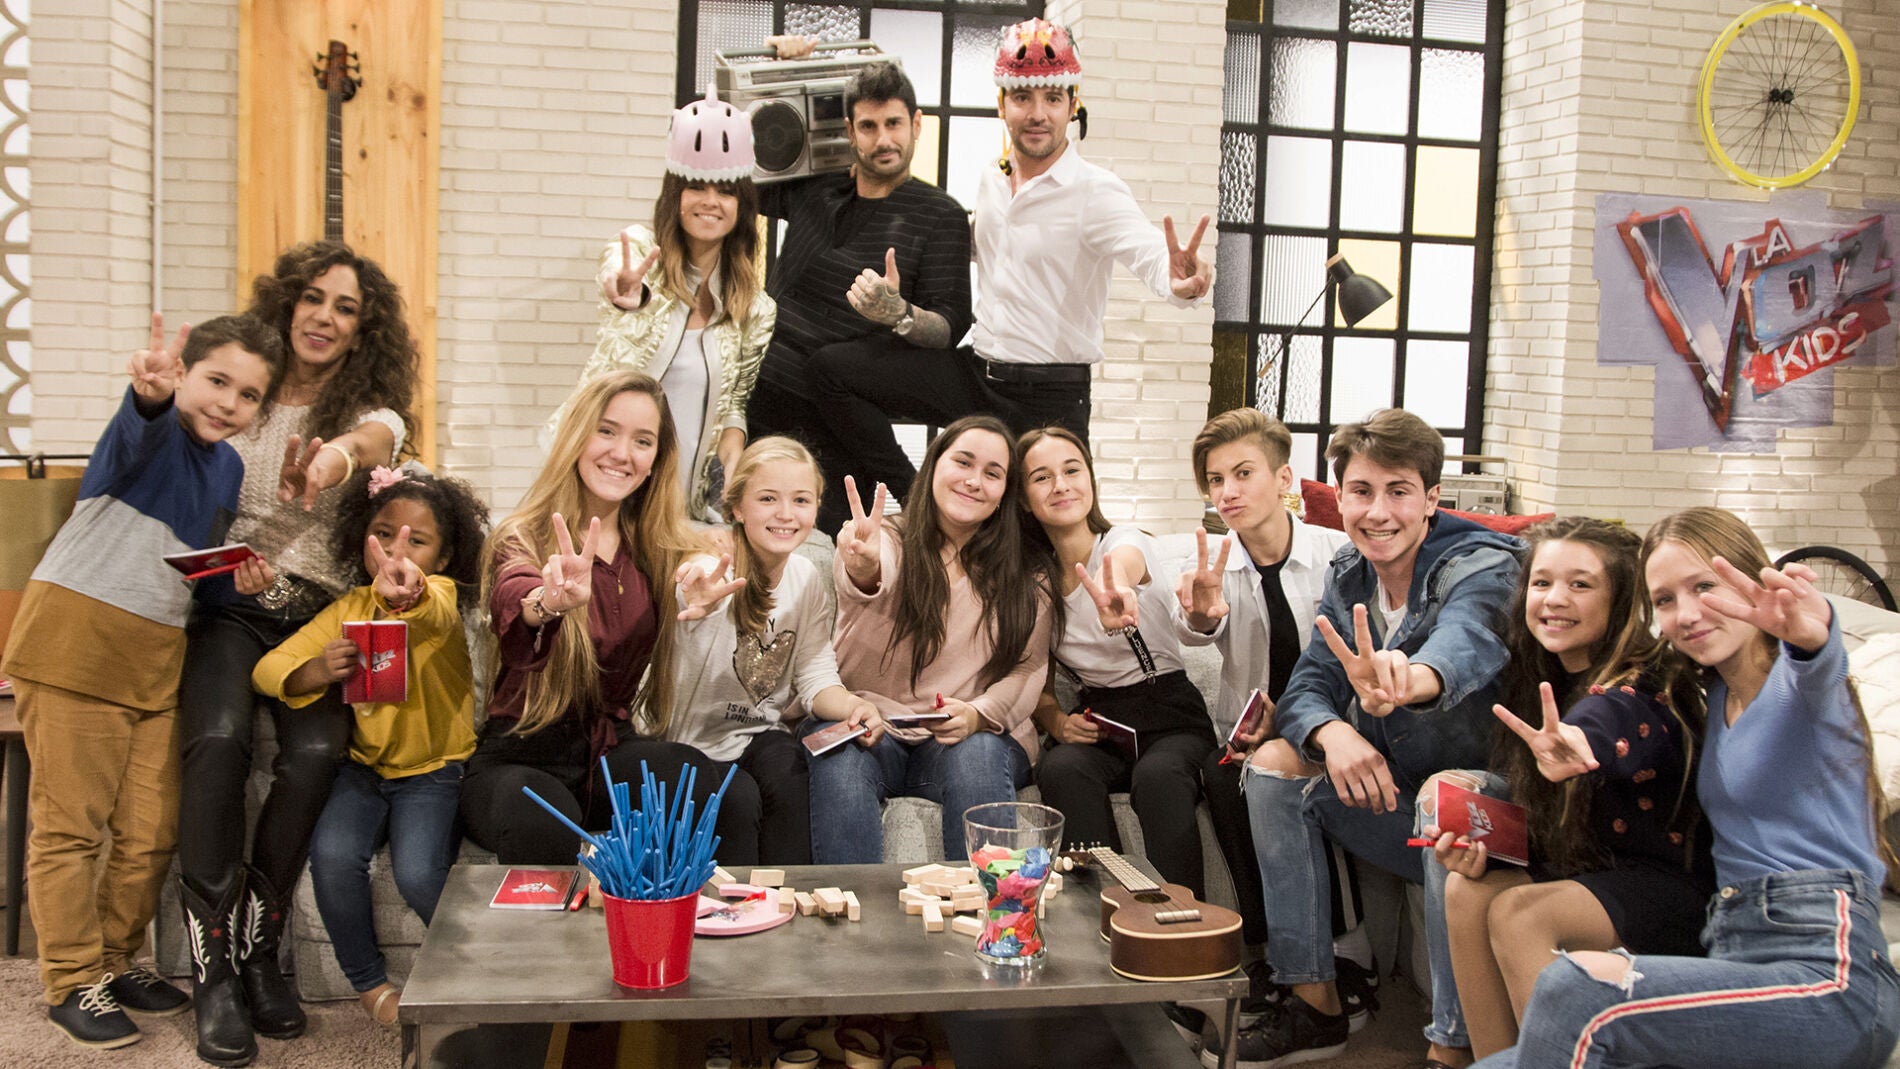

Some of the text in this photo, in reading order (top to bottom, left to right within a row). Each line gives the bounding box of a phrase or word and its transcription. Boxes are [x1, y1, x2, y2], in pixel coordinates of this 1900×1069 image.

[1751, 225, 1792, 267] LA
[1616, 206, 1894, 435] VOZ
[1773, 312, 1868, 384] KIDS
[727, 702, 749, 716] IS IN
